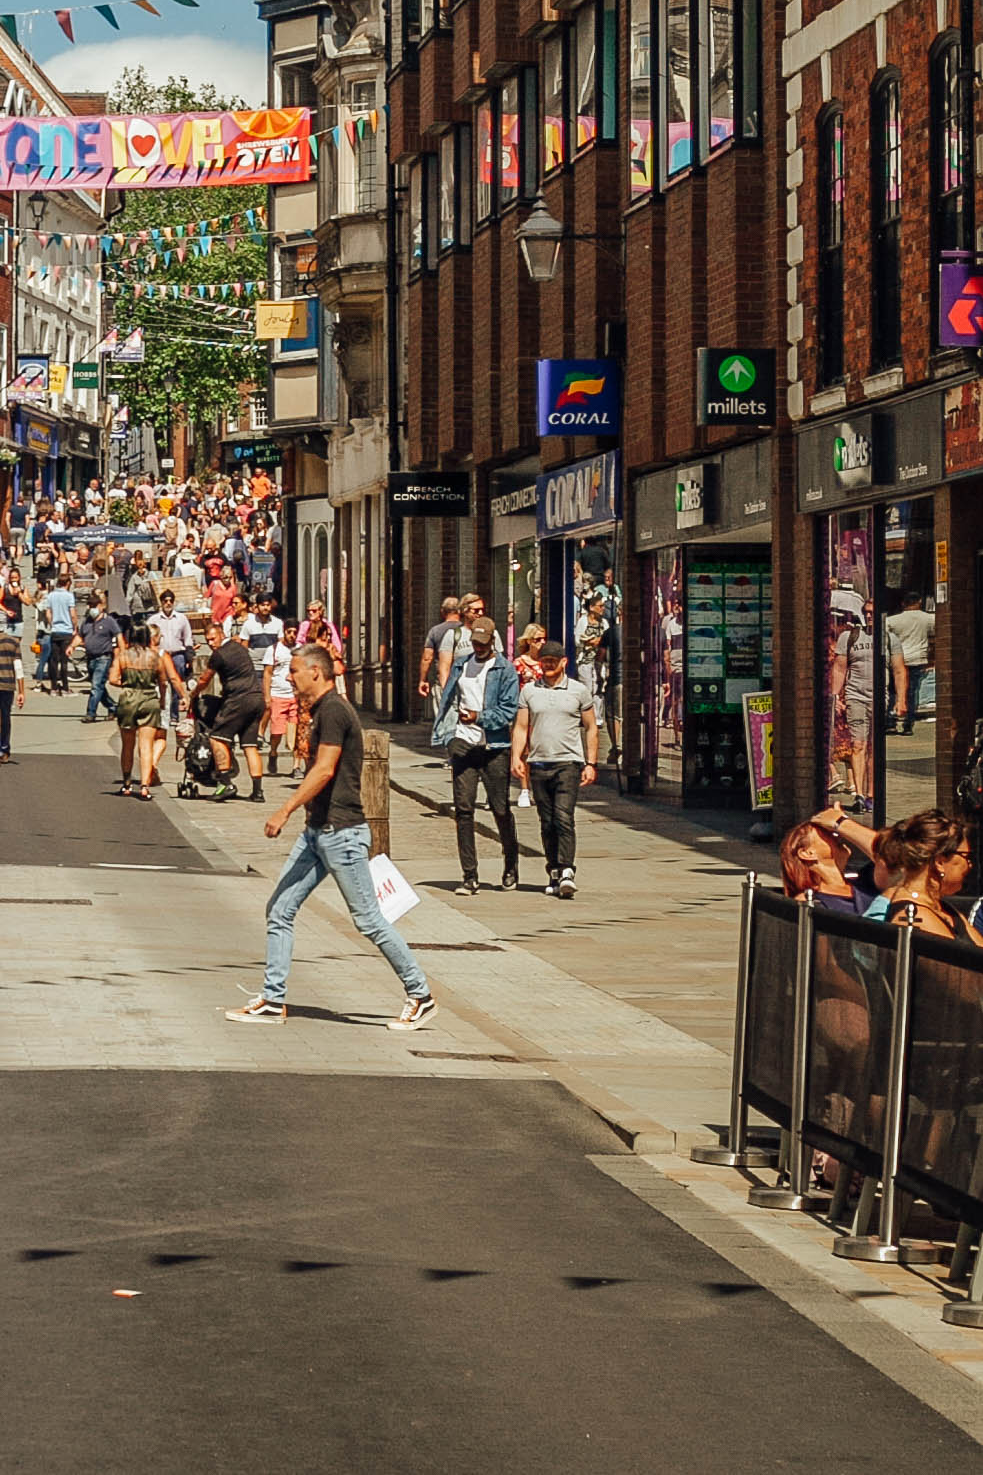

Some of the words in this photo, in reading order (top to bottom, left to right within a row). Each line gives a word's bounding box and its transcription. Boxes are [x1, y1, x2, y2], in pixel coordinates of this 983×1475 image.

[73, 371, 97, 379] HOBBS
[707, 397, 767, 416] millets
[548, 412, 610, 425] CORAL
[393, 493, 466, 501] CONNECTION
[545, 466, 593, 530] CORAL
